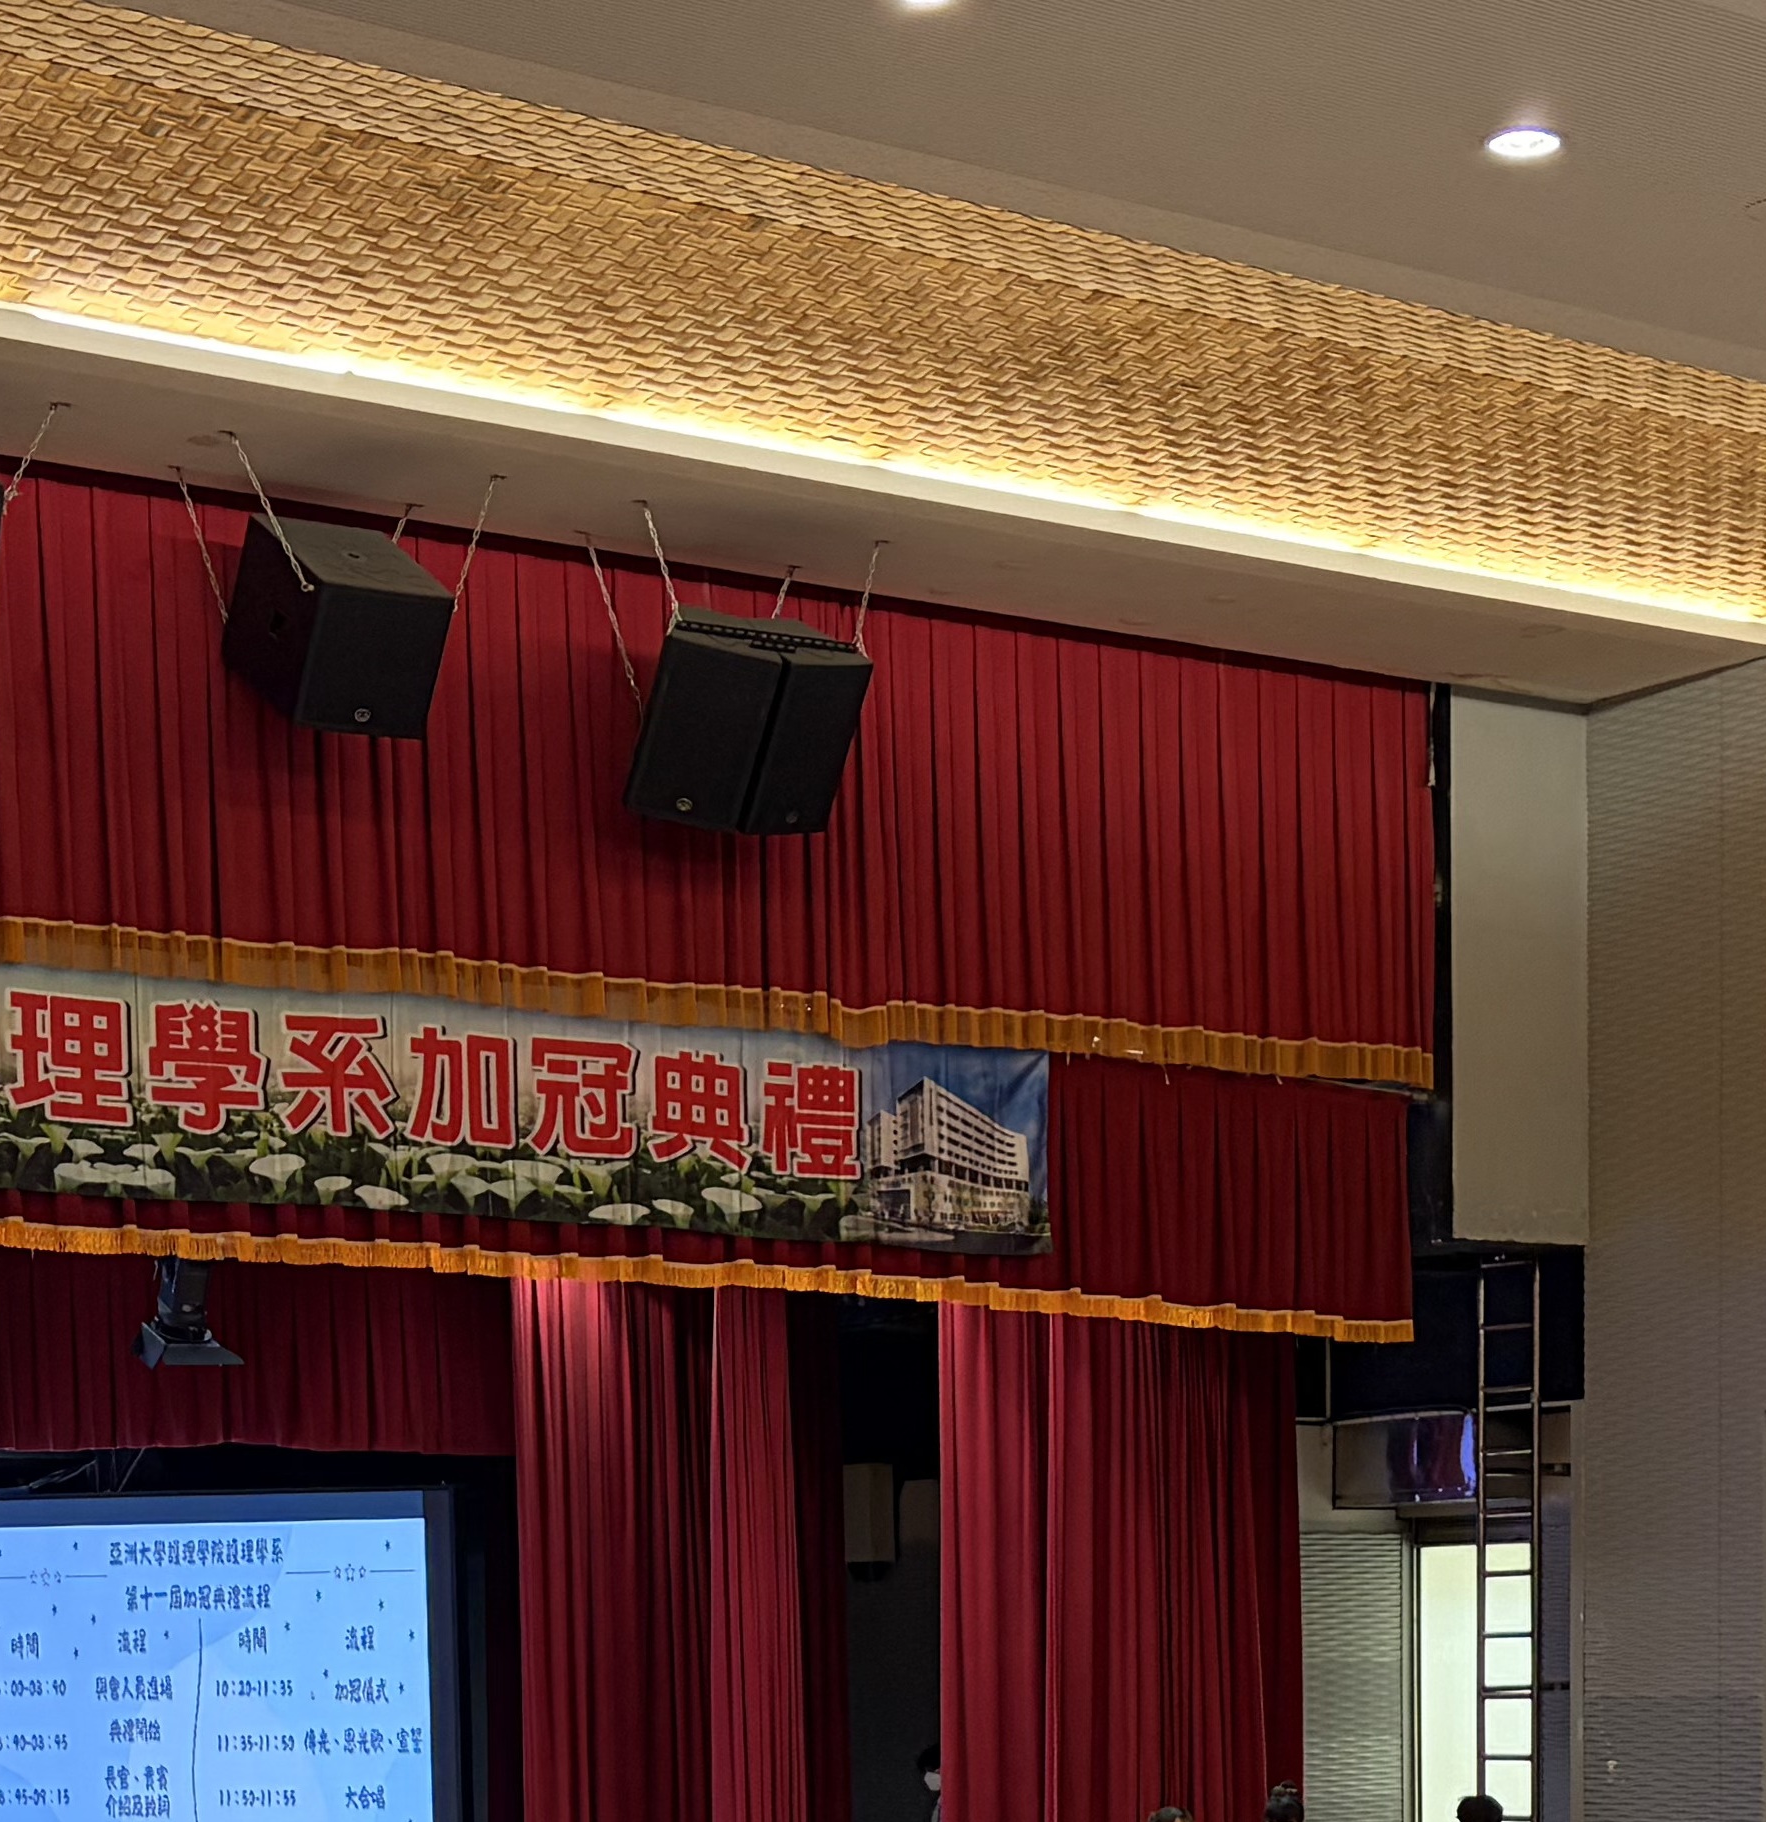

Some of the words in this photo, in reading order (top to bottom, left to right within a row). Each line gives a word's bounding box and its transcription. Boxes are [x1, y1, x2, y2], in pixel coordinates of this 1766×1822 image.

[109, 1537, 284, 1567] 亞洲大學護理學院護理學系
[125, 1583, 272, 1612] 第十一屆加冠典禮流程
[10, 1632, 40, 1660] 時間
[117, 1628, 147, 1654] 流程
[238, 1626, 267, 1654] 時間
[345, 1625, 375, 1652] 流程
